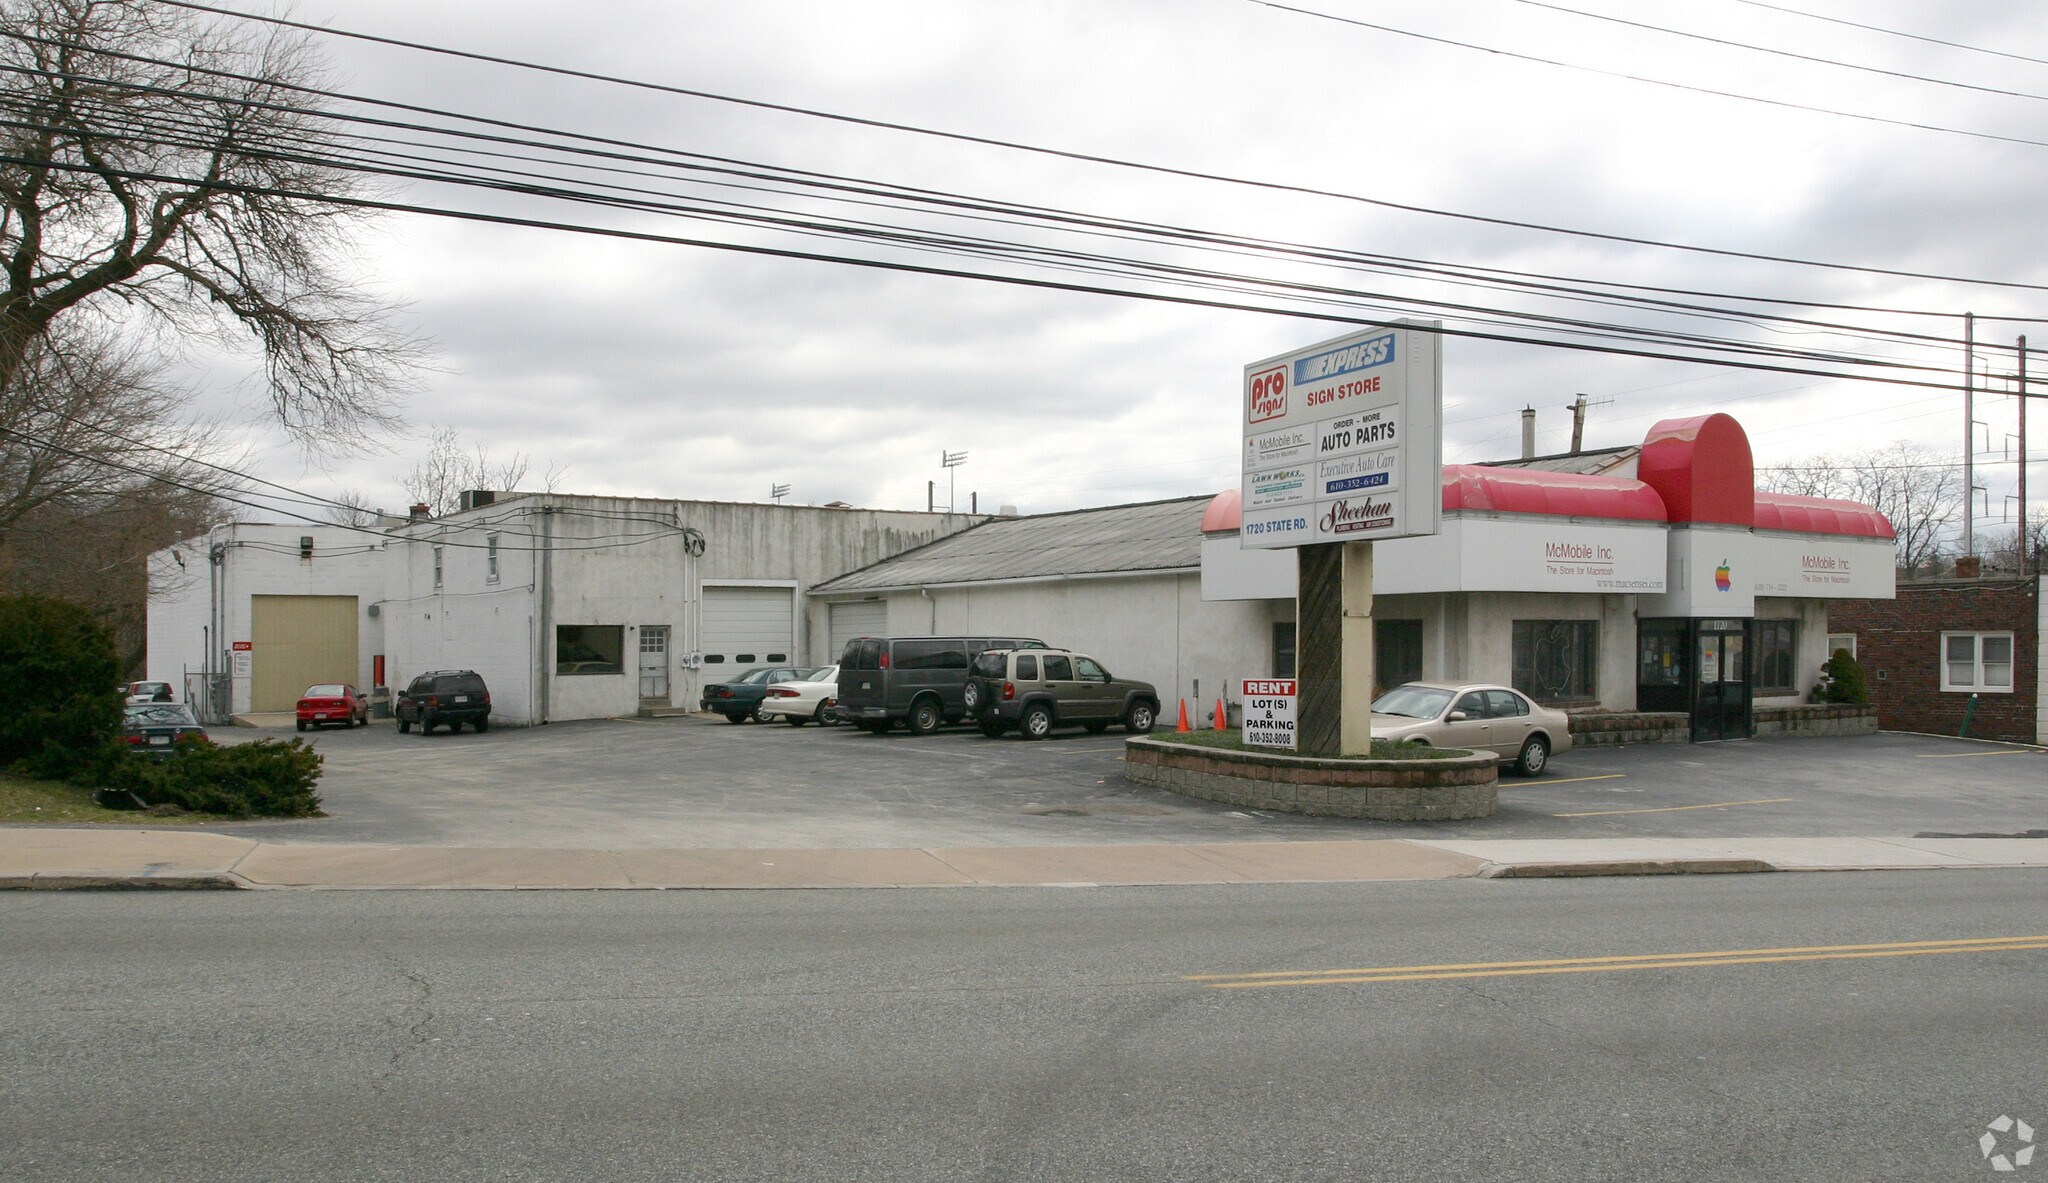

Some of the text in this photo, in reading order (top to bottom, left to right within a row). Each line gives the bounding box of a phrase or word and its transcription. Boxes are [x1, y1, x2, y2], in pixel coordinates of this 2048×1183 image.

[1316, 337, 1391, 376] EXPRESS
[1307, 376, 1381, 407] SIGN STORE
[1257, 397, 1284, 416] signs
[1333, 419, 1354, 430] ORDER
[1362, 412, 1381, 423] MORE
[1259, 436, 1291, 450] McMobile
[1321, 421, 1395, 452] AUTO PARTS
[1320, 452, 1395, 478] Executive Auto Care
[1251, 474, 1273, 483] LAWN
[1330, 475, 1384, 491] 610-352-6424
[1320, 497, 1391, 532] Sheehan
[1246, 518, 1308, 535] 1720 STATE RD.
[1545, 542, 1614, 560] McMobile Inc.
[1547, 565, 1614, 576] The Store for Macintosh
[1802, 555, 1850, 570] McMobile Inc.
[1713, 621, 1728, 630] 1720
[1247, 682, 1291, 694] RENT
[1252, 699, 1287, 710] LOT(S)
[1265, 709, 1273, 719] &
[1246, 719, 1294, 730] PARKING
